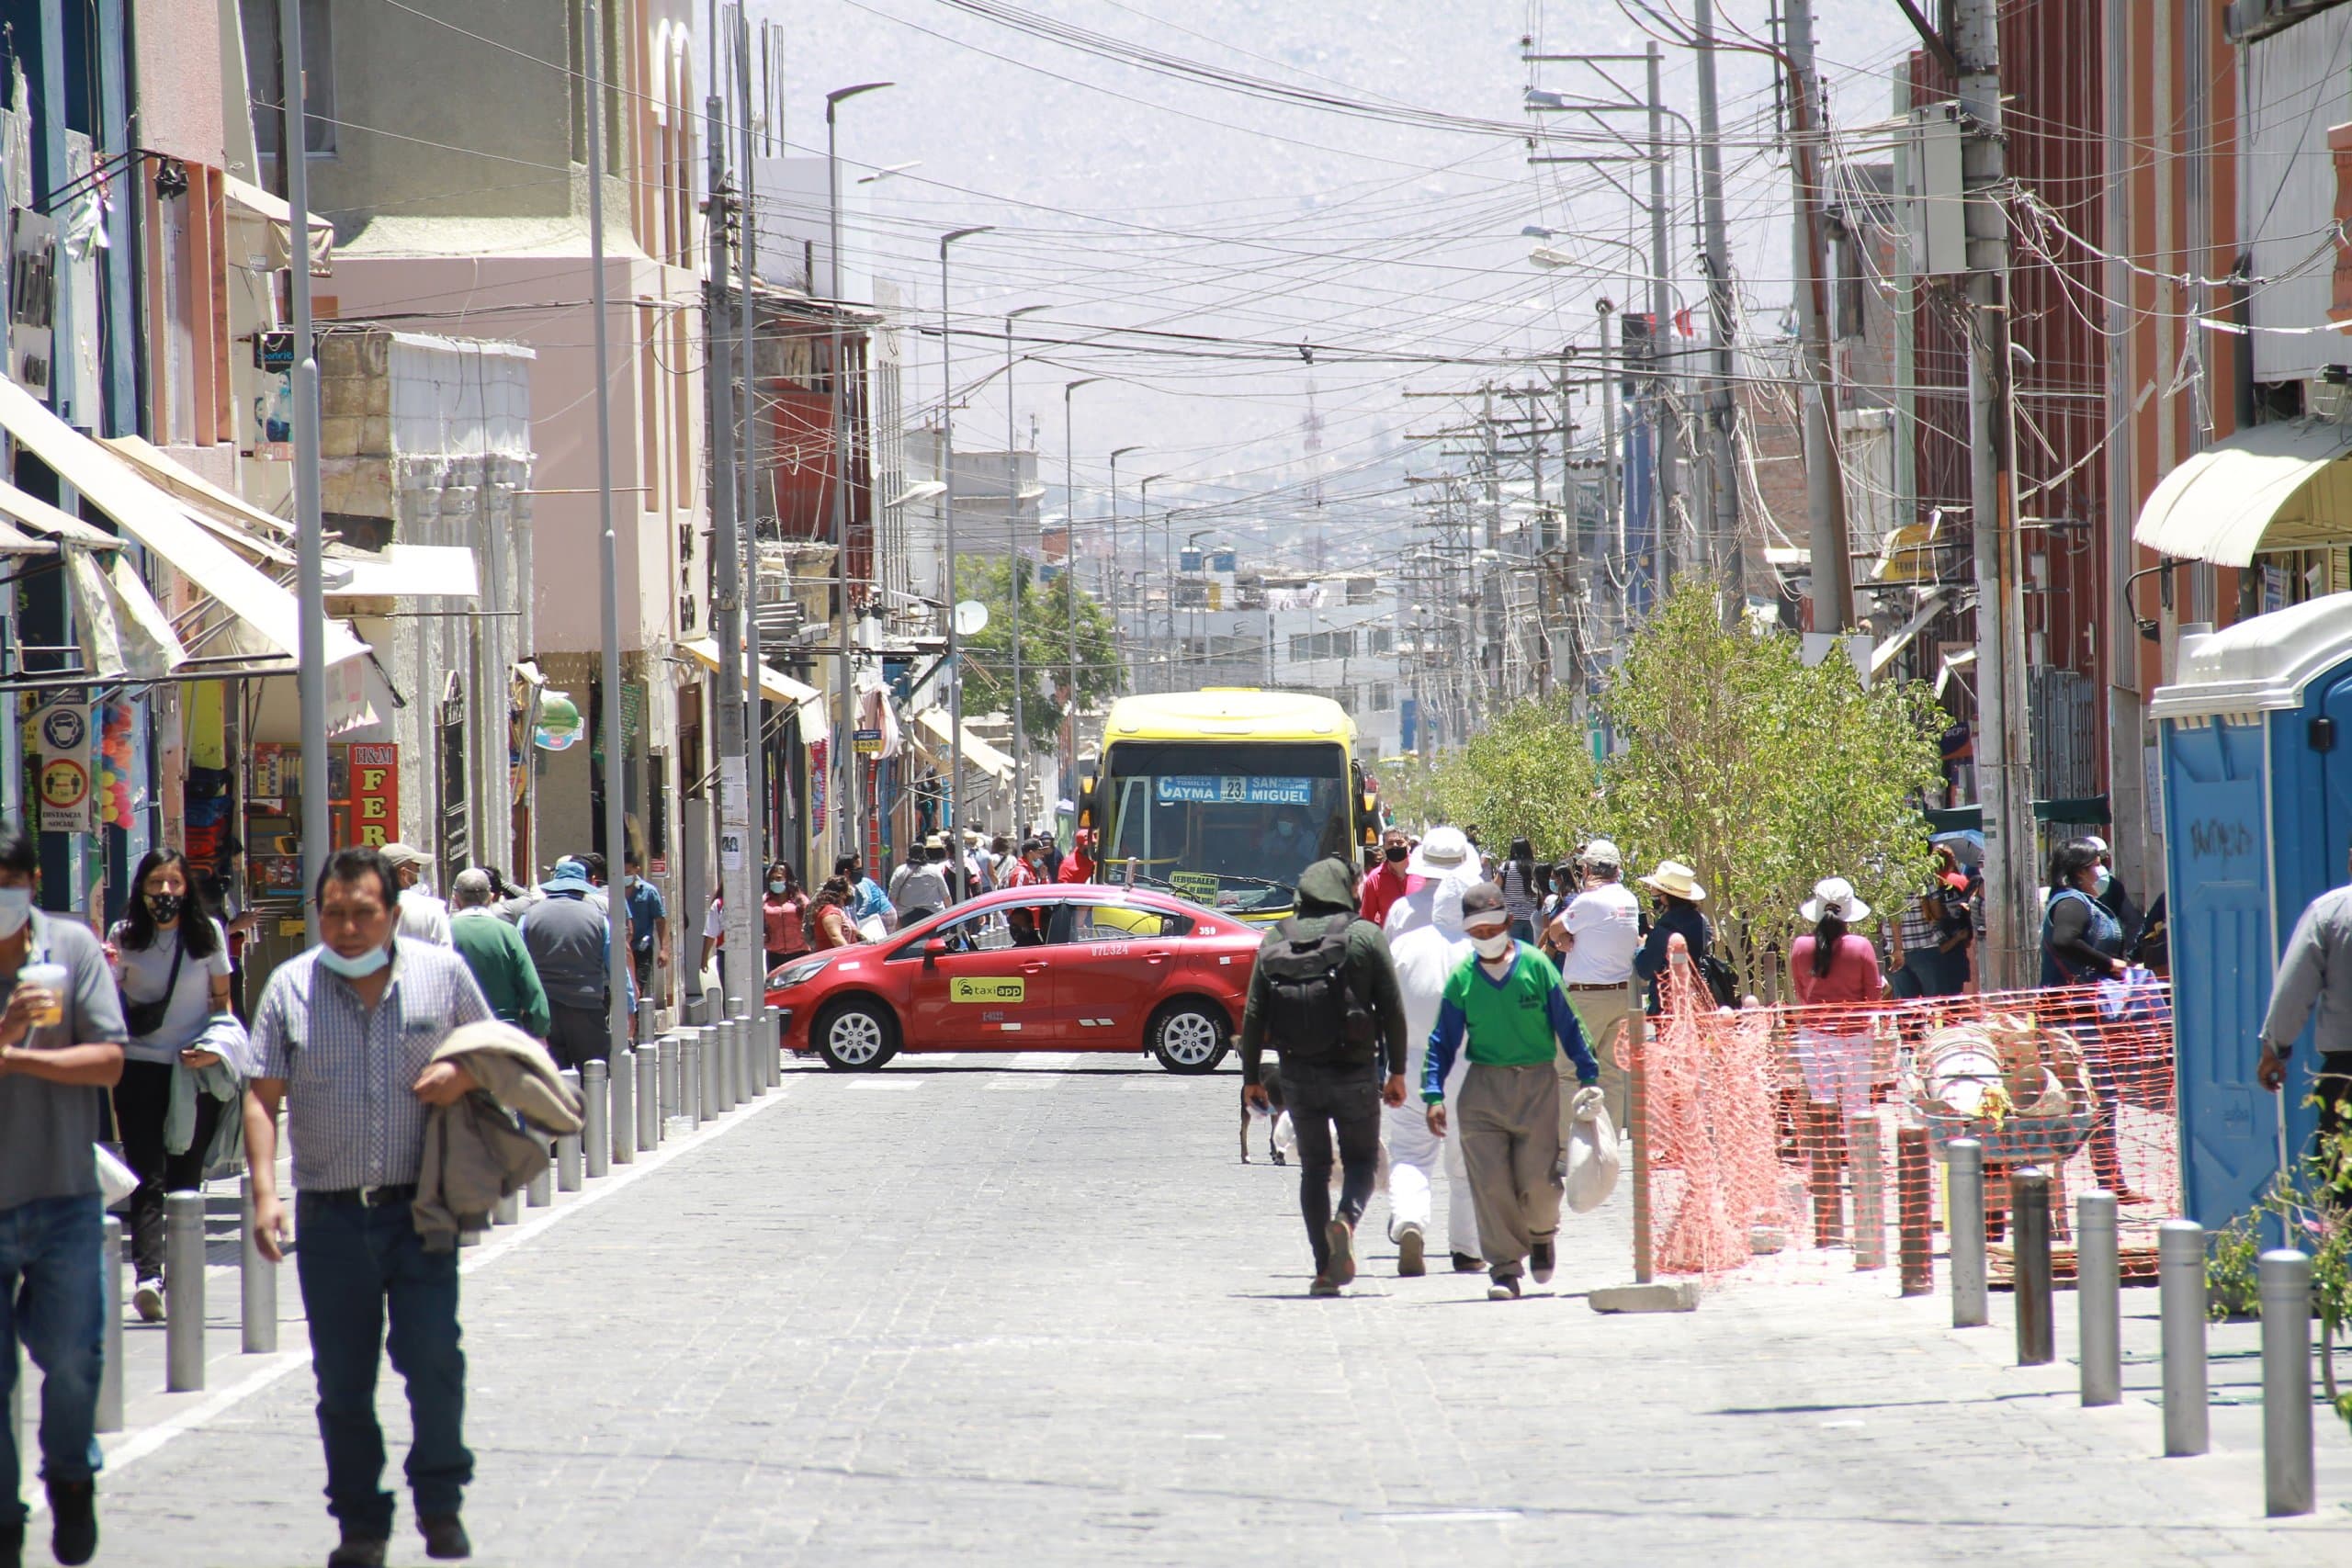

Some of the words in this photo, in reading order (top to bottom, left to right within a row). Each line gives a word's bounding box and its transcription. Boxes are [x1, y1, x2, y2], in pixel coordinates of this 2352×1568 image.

[355, 747, 393, 765] H&M
[1159, 776, 1214, 799] CAYMA
[1227, 782, 1242, 798] 23
[1252, 777, 1278, 789] SAN
[1252, 789, 1307, 802] MIGUEL
[1199, 927, 1216, 935] 359
